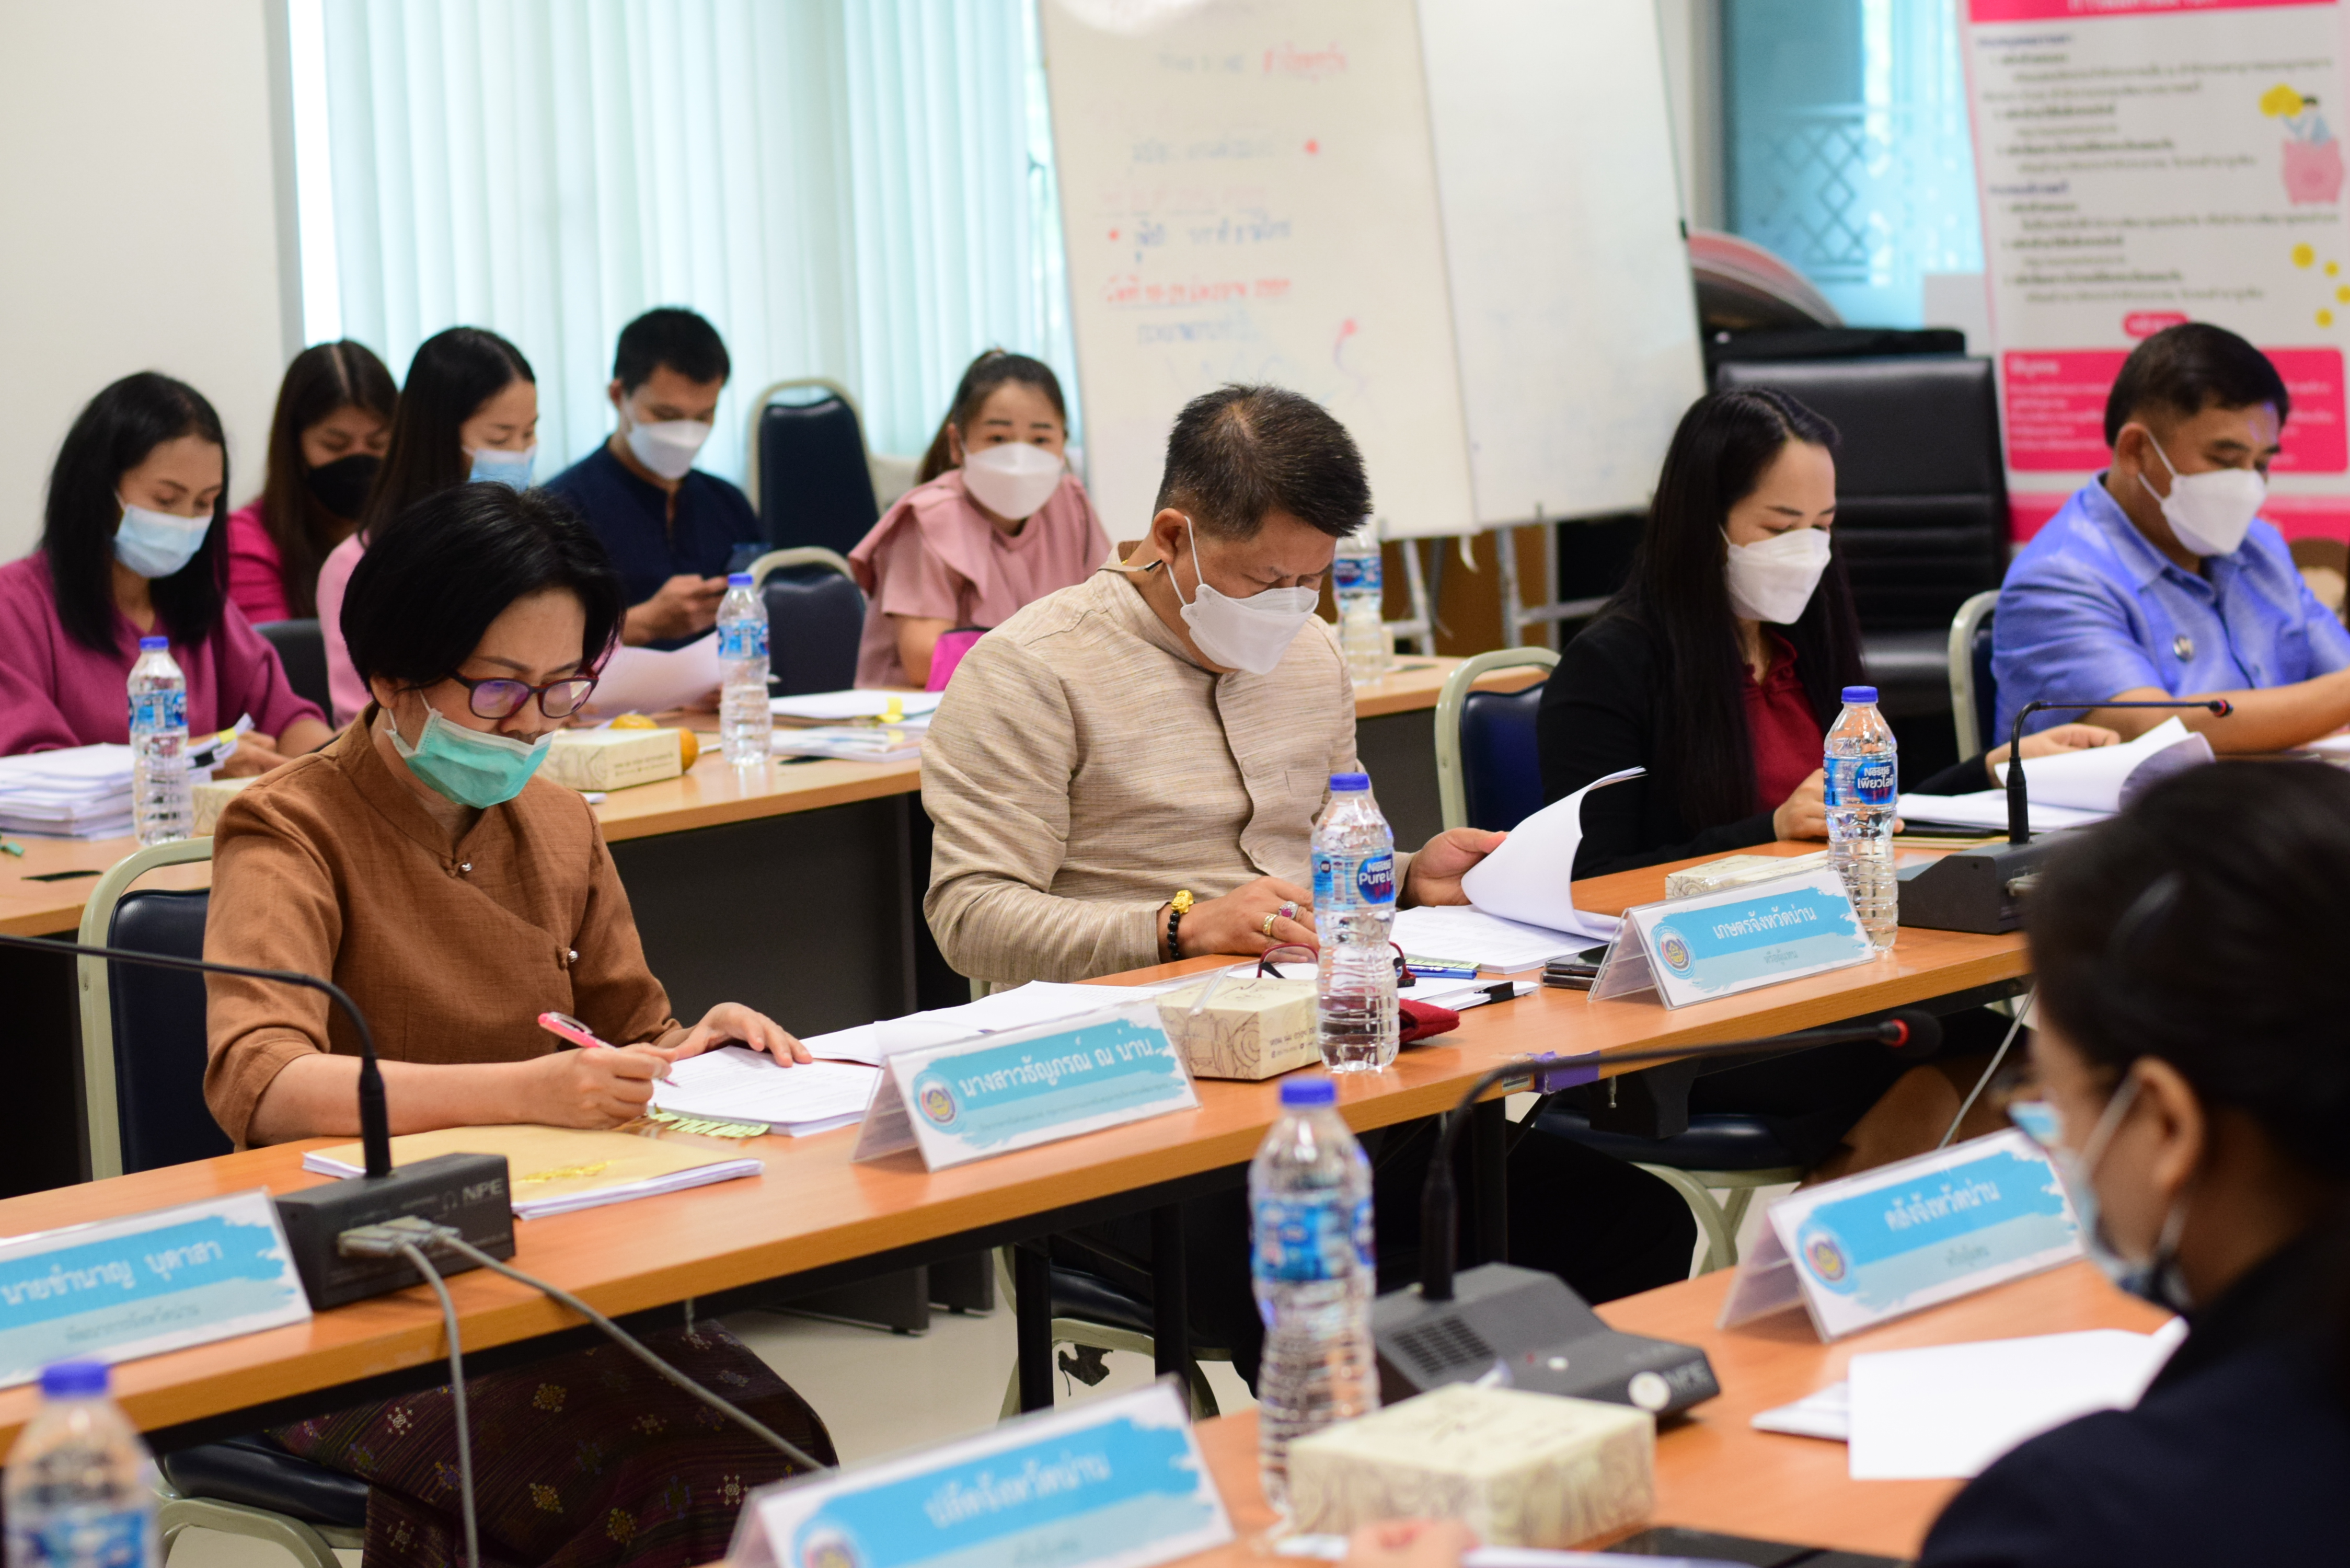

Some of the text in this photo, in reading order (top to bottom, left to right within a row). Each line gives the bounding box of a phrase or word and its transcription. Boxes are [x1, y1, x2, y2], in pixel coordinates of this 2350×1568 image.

[1713, 904, 1817, 939] เกษตรจังหวัดน่าน
[1095, 1047, 1115, 1067] ณ
[1116, 1028, 1154, 1062] น่าน
[463, 1178, 503, 1204] NPE
[1884, 1177, 2001, 1232] คลังจังหวัดน่าน
